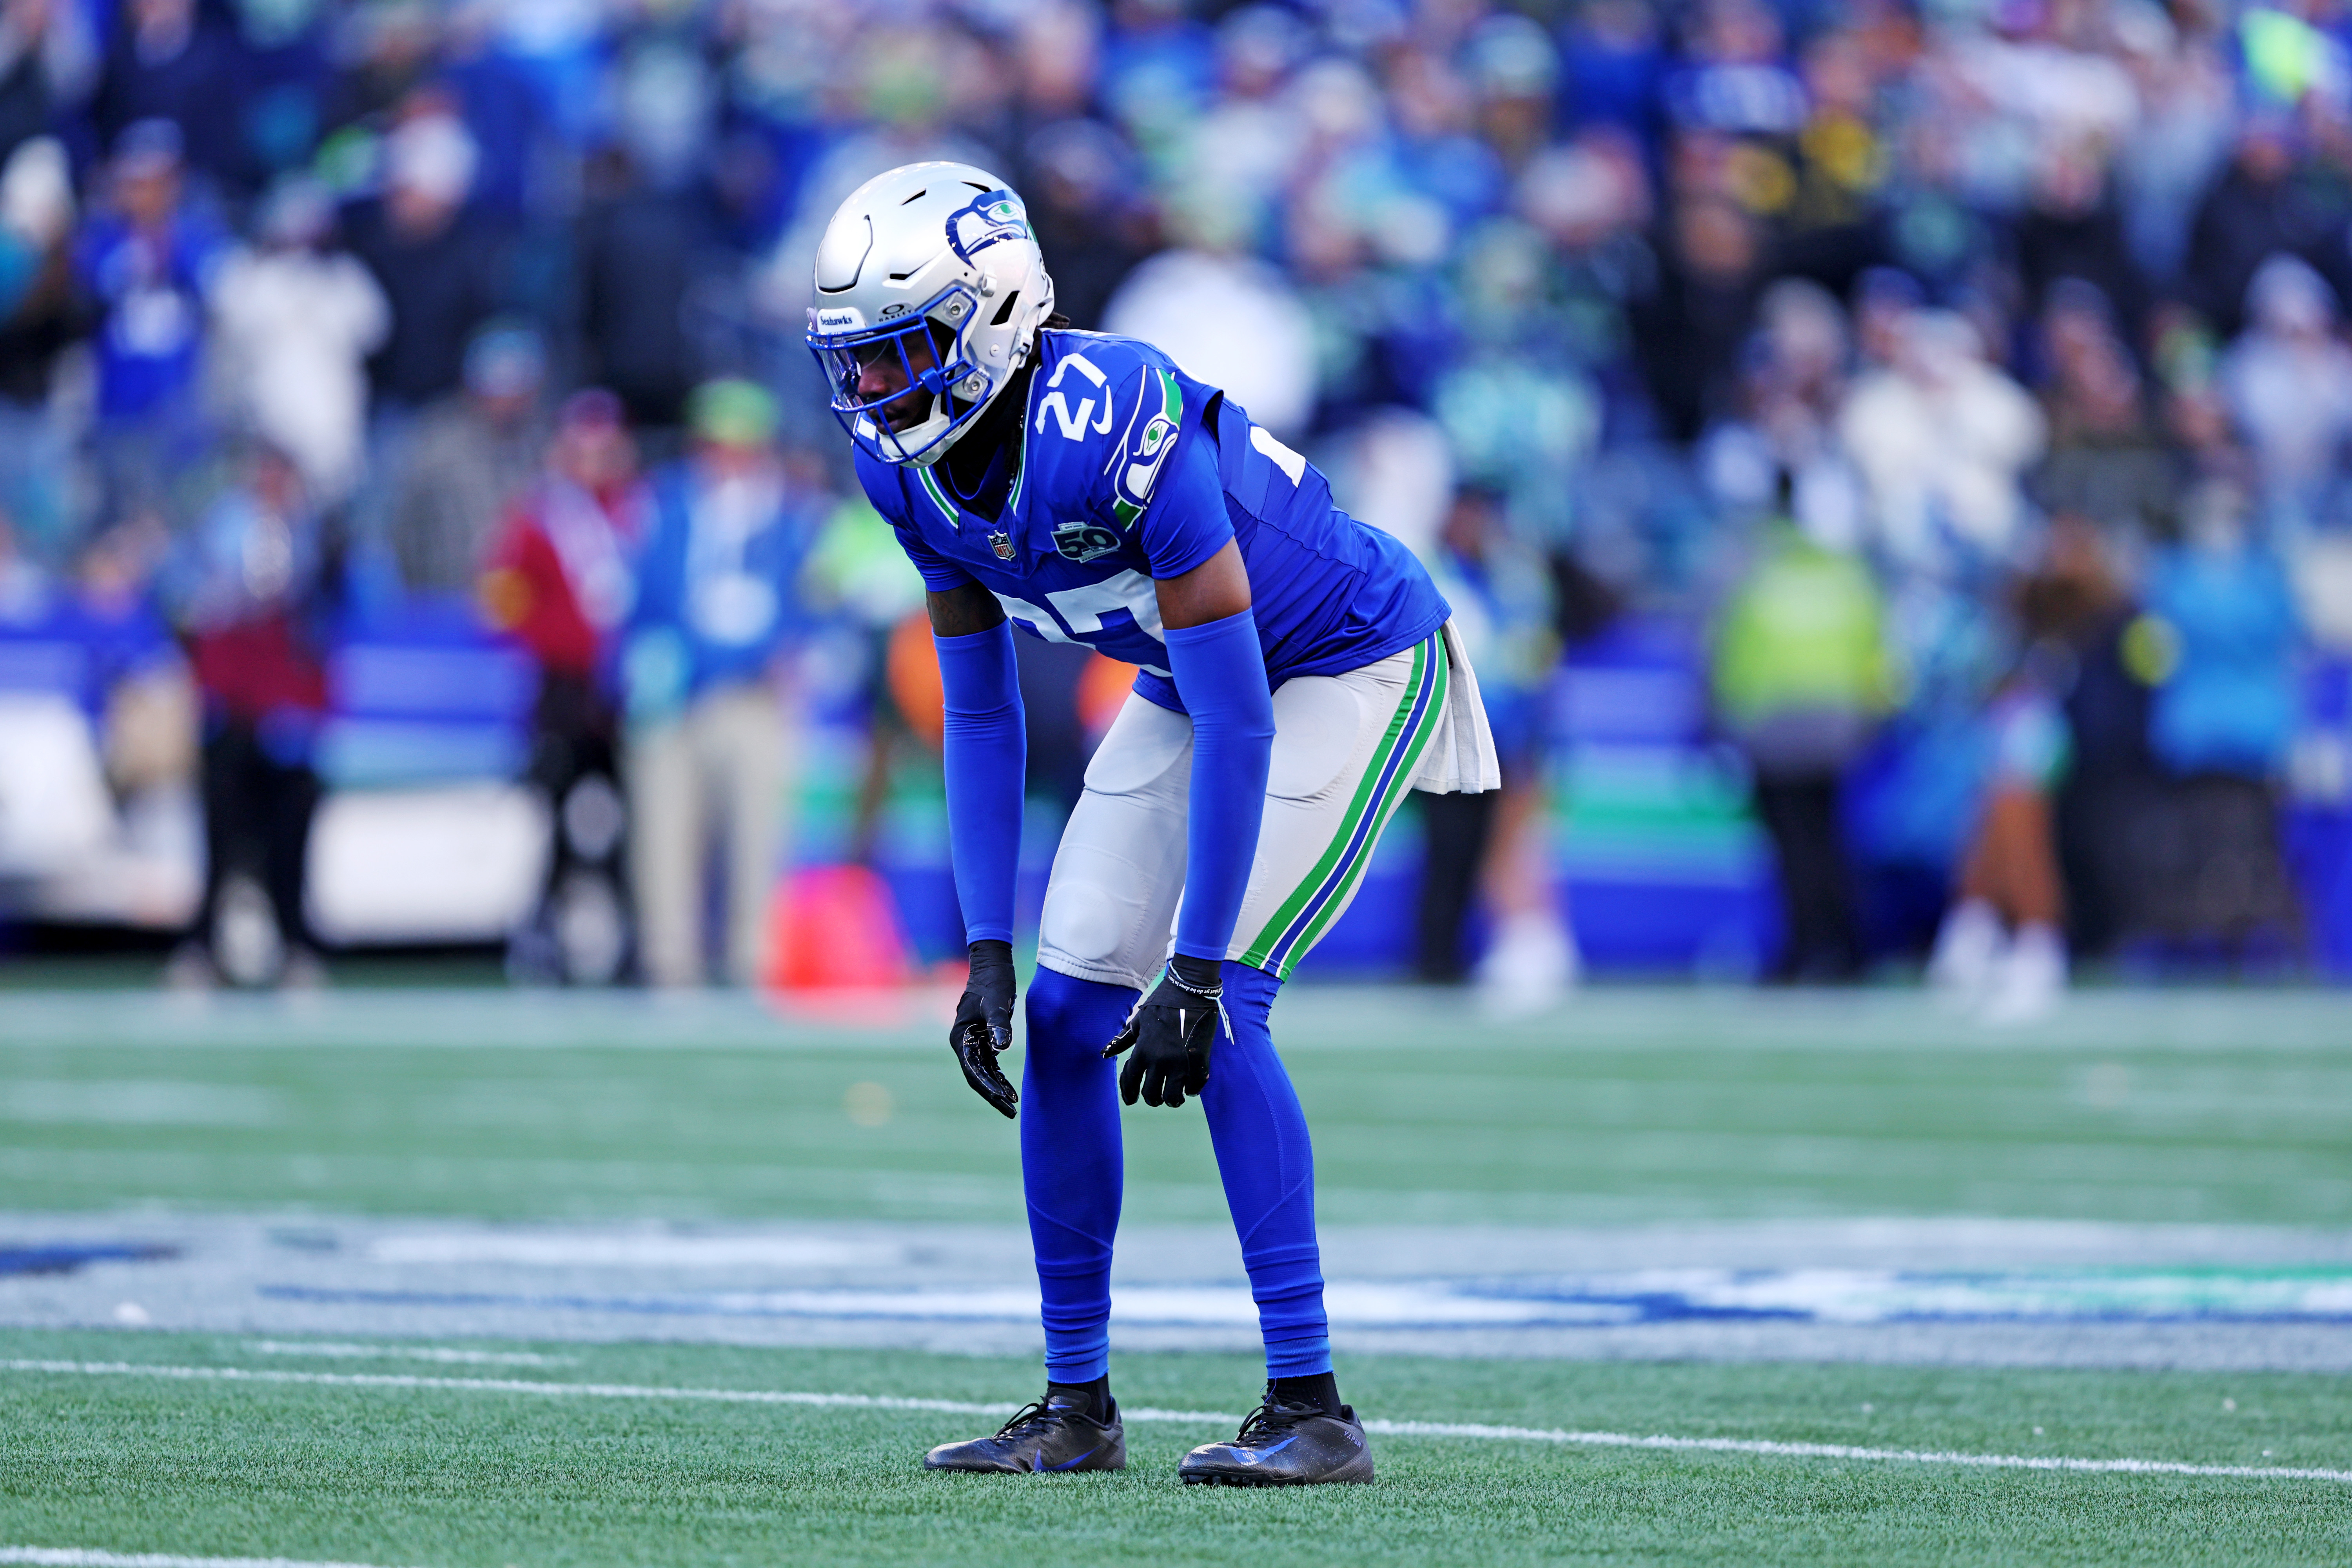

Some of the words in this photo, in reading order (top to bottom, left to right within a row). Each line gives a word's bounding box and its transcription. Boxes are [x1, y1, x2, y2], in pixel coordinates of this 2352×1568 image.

[820, 315, 852, 325] Seahawks
[1035, 353, 1107, 442] 27
[996, 544, 1013, 556] NFL
[1054, 529, 1118, 558] 50
[1344, 1430, 1361, 1448] VAPOR
